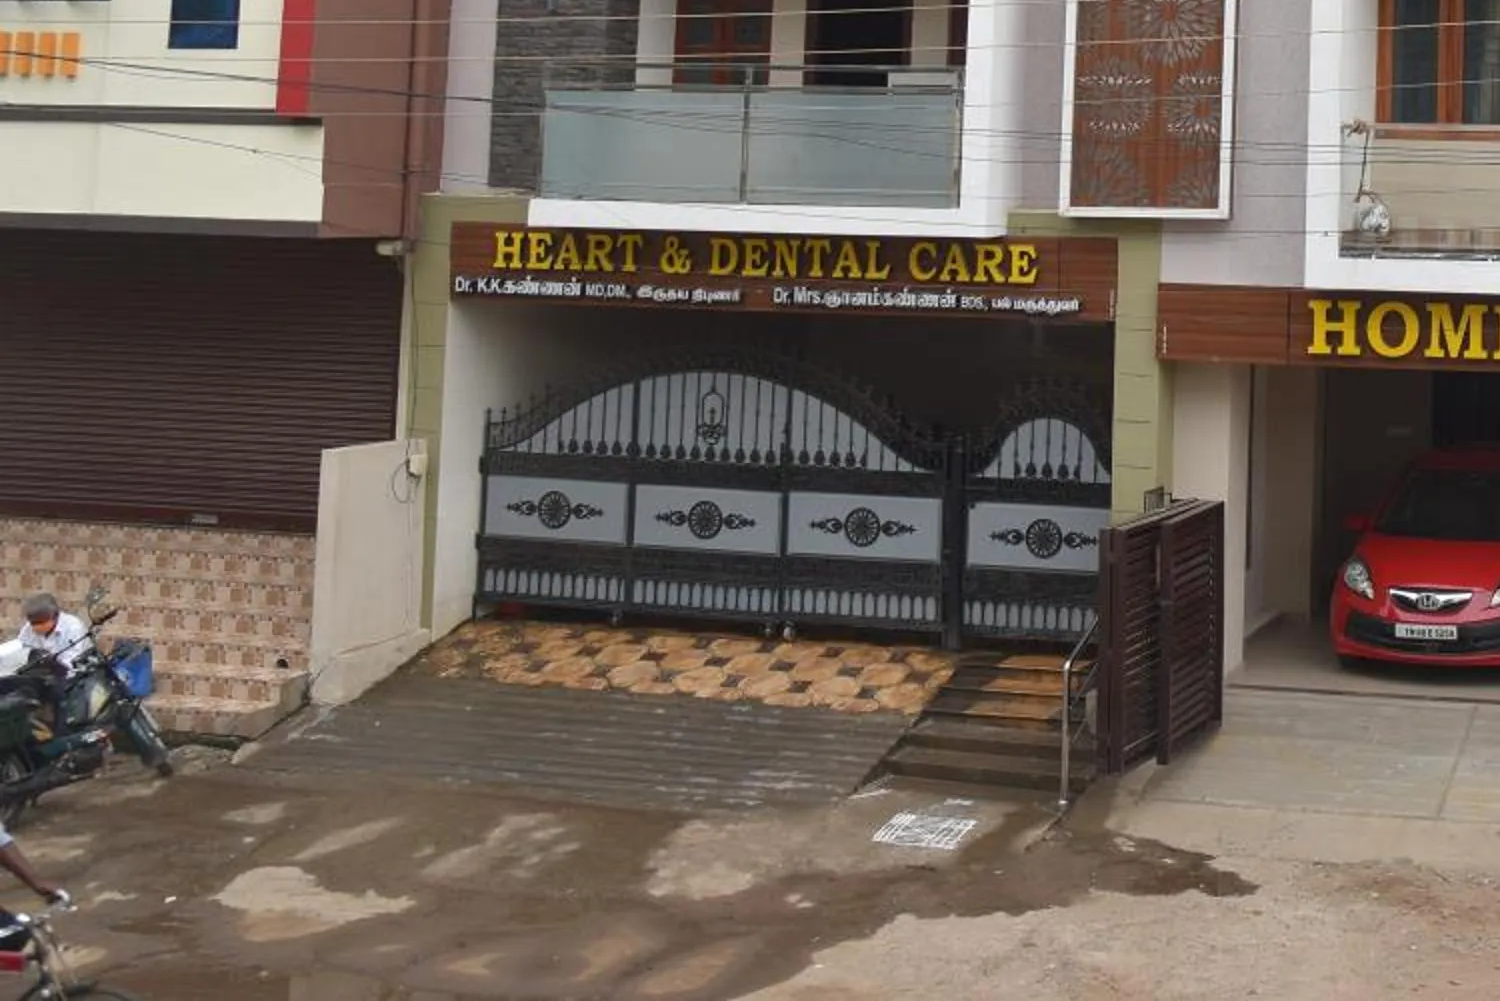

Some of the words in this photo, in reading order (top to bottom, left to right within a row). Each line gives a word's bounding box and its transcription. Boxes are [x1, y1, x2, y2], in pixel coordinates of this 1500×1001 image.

[492, 231, 643, 273] HEART
[659, 236, 693, 274] &
[708, 237, 892, 280] DENTAL
[908, 241, 1039, 285] CARE
[454, 275, 474, 293] Dr.
